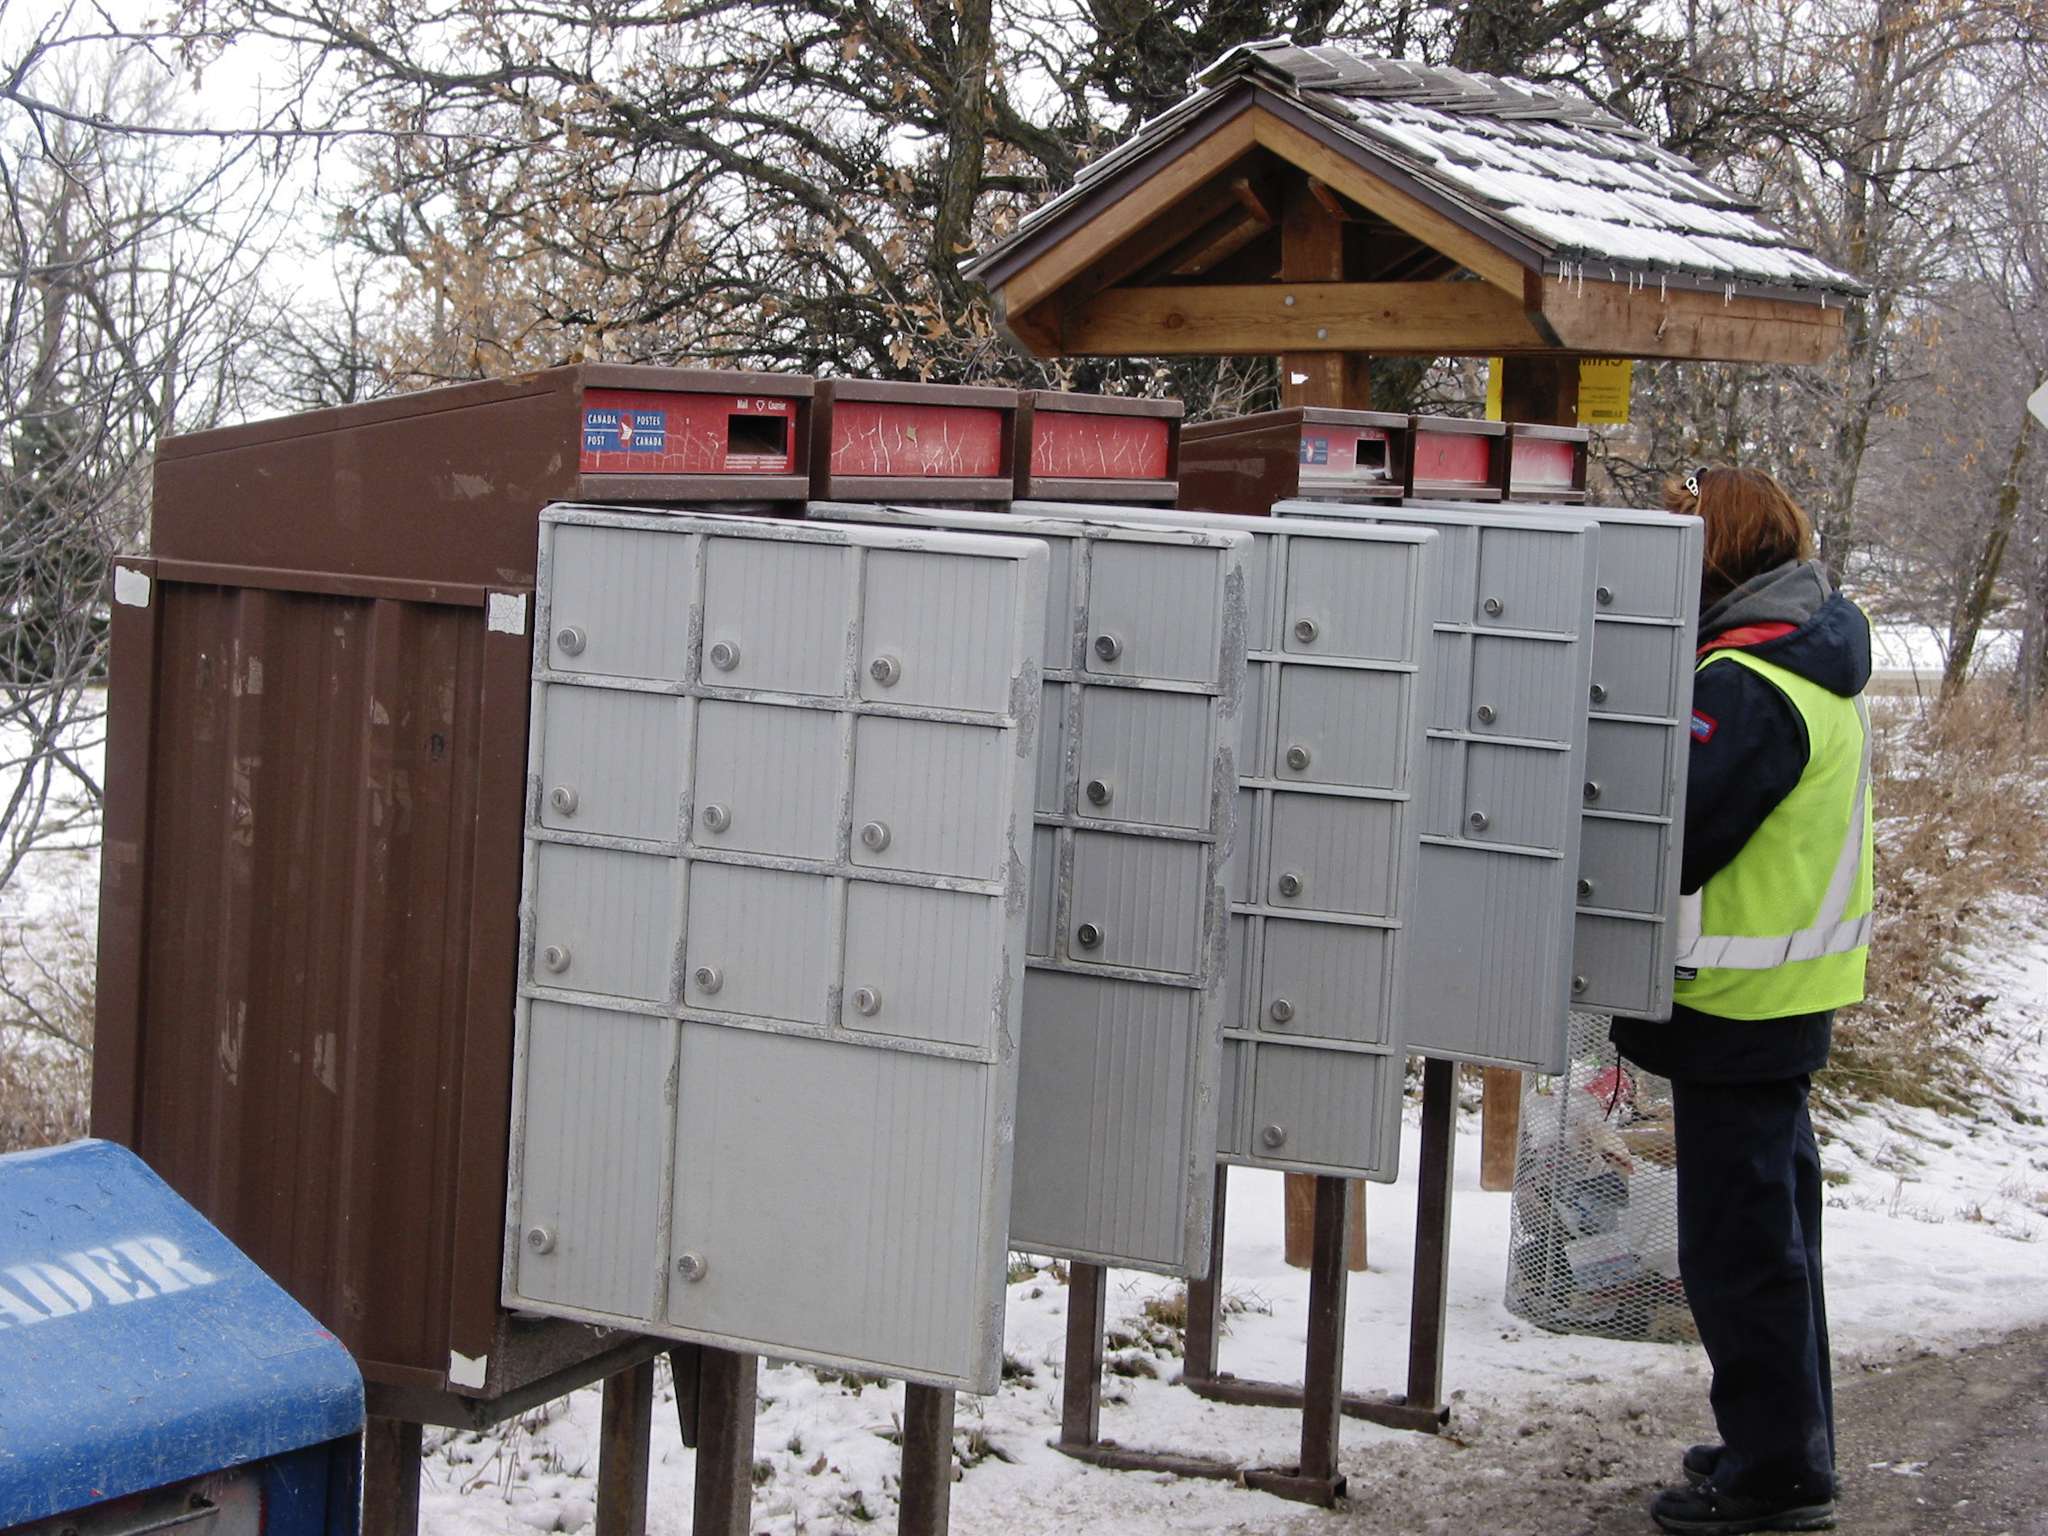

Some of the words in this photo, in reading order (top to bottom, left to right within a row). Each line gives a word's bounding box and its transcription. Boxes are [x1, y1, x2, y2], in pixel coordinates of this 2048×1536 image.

[587, 414, 617, 425] CANADA
[636, 415, 660, 426] POSTES
[587, 435, 605, 446] POST
[635, 436, 663, 447] CANADA
